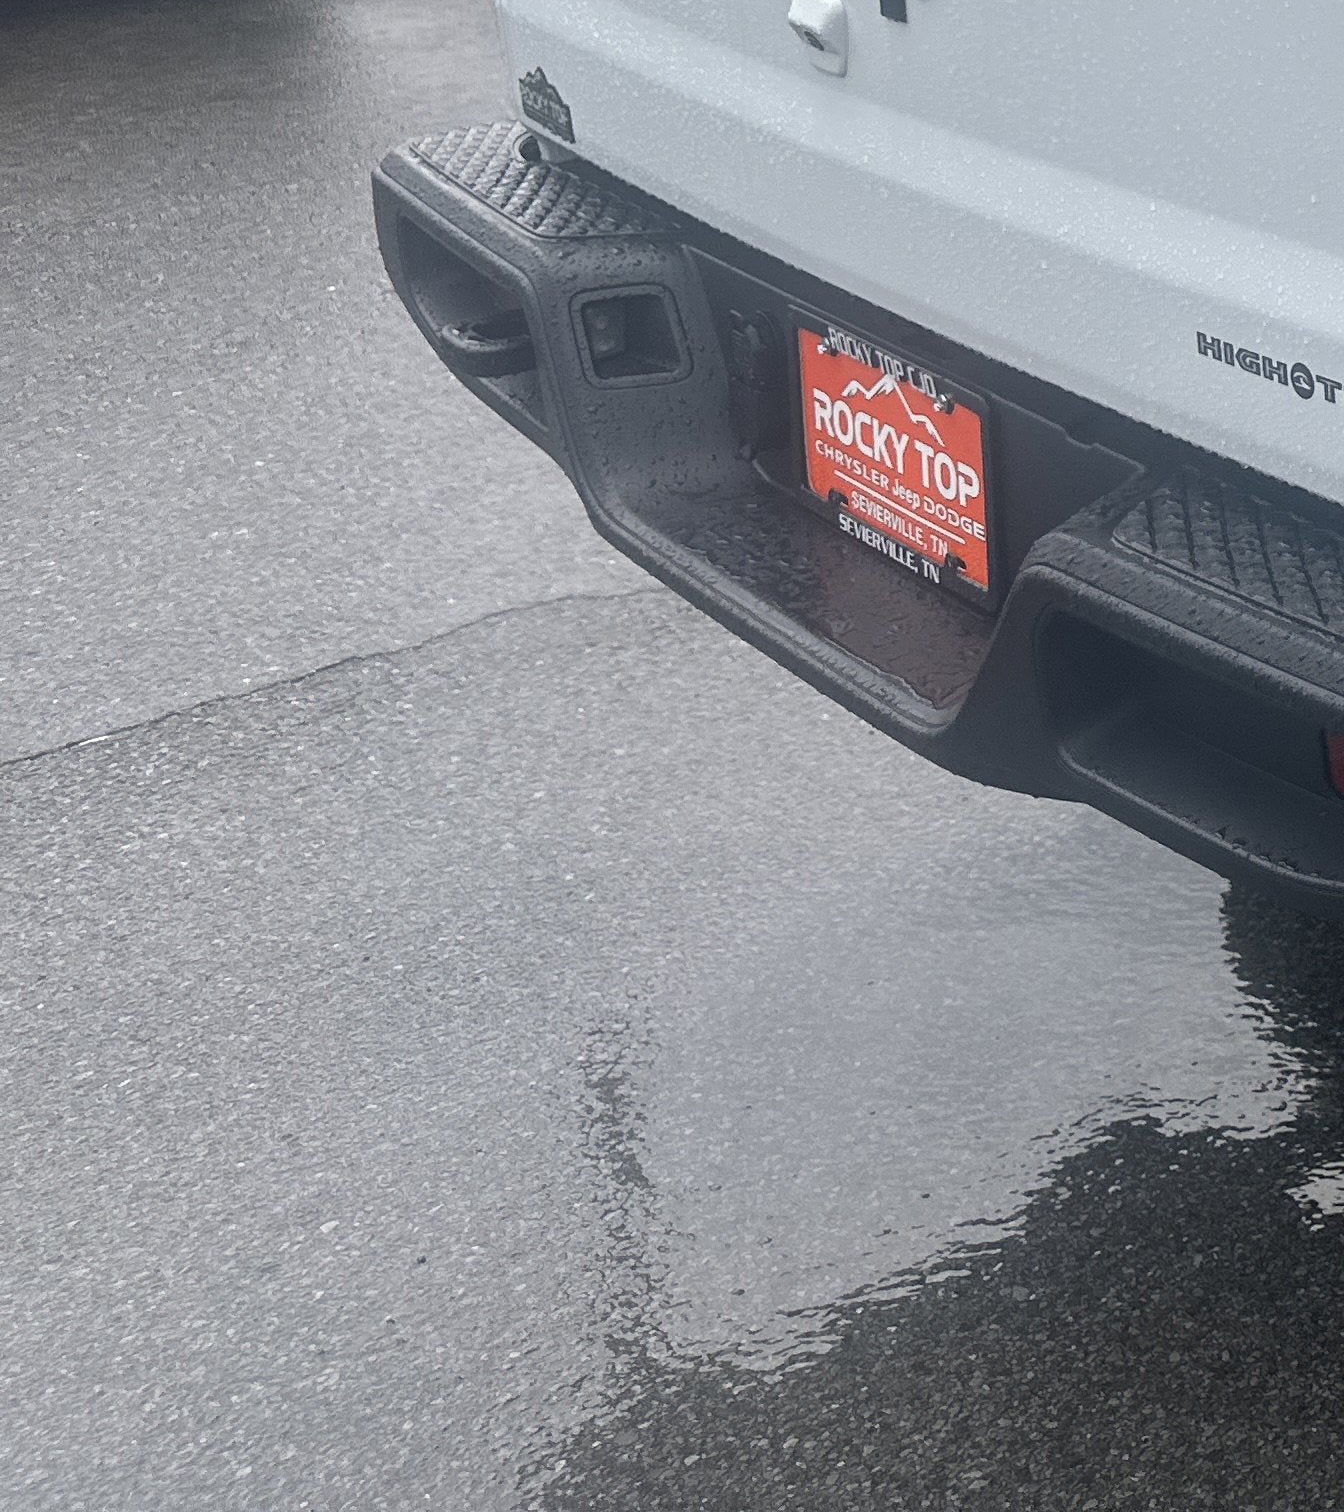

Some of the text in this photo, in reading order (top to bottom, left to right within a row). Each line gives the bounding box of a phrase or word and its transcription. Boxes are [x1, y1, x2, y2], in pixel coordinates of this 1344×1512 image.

[827, 327, 873, 368] ROCKY
[875, 350, 905, 382] TOP
[1196, 331, 1289, 386] HIGH
[813, 388, 980, 507] ROCKY TOP
[815, 439, 986, 541] CHRYSLER Jeep DODGE
[851, 490, 949, 558] SEVIERVILLE, TN
[839, 512, 940, 584] SEVIERVILLE, TN
